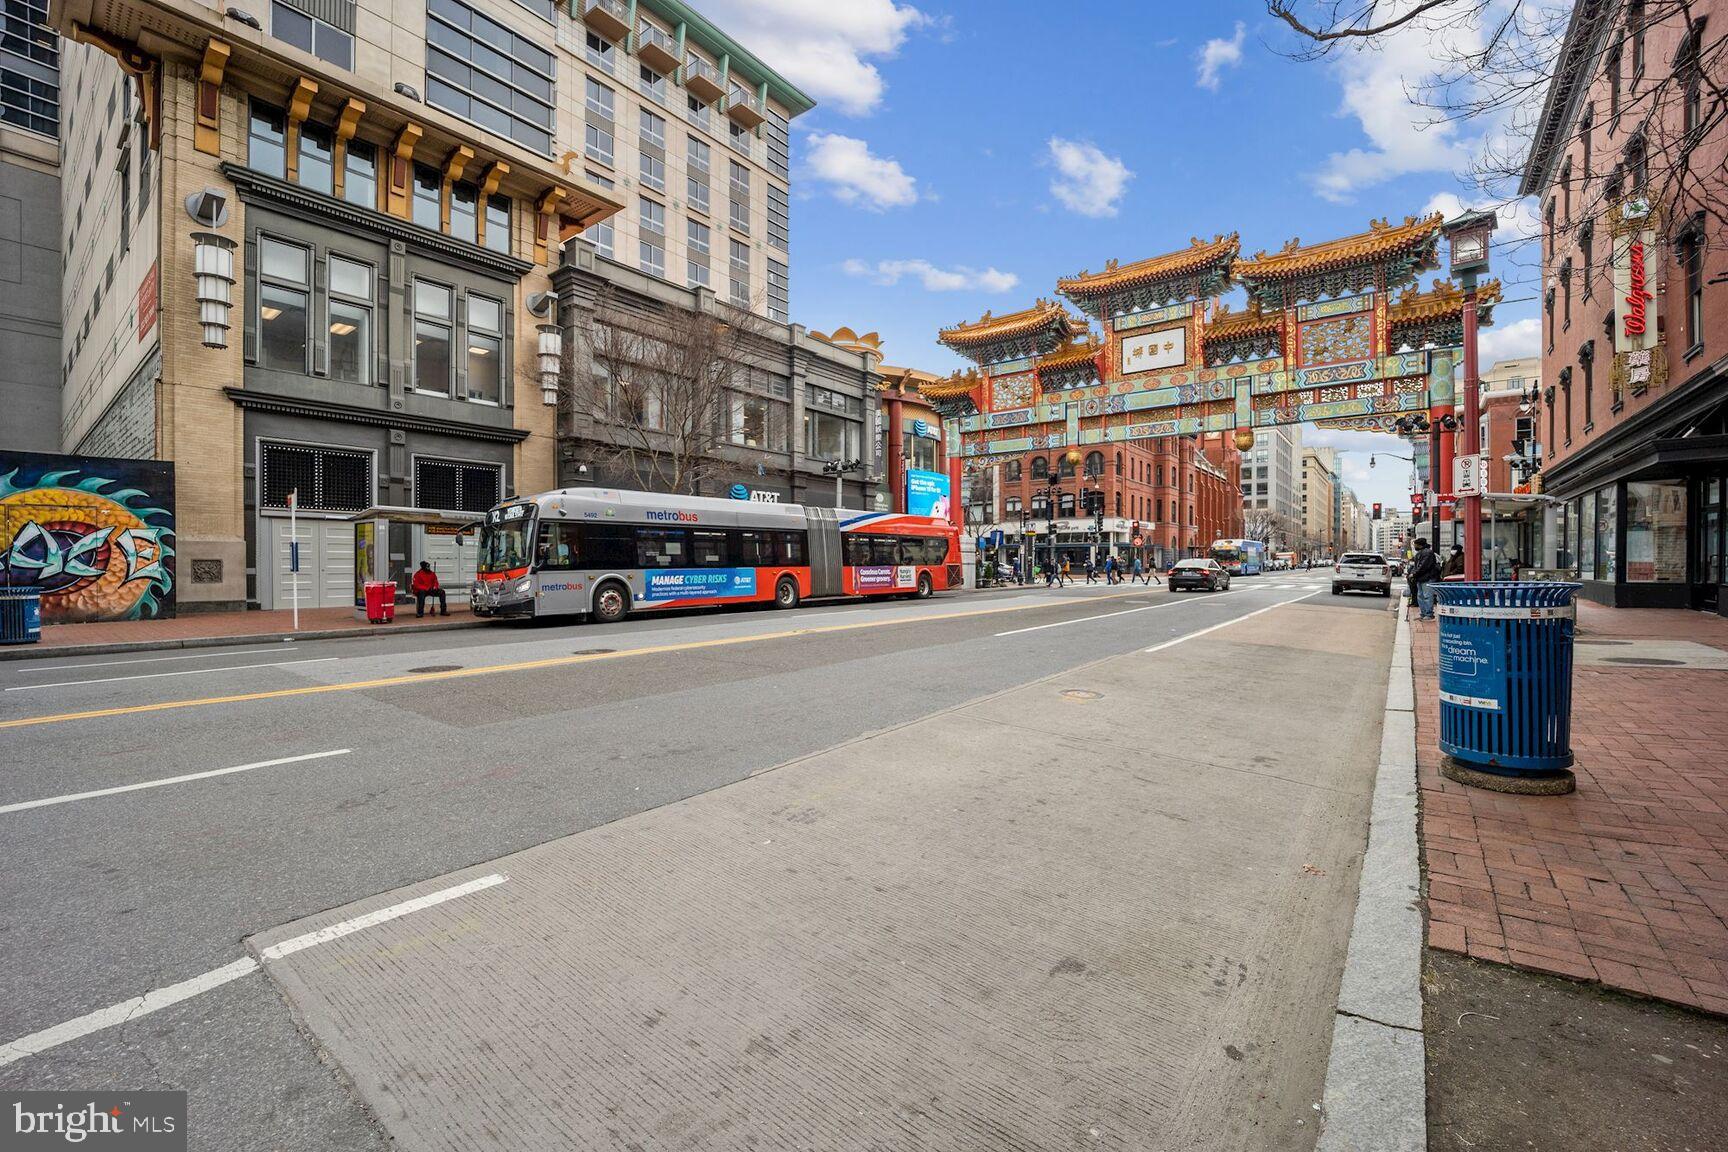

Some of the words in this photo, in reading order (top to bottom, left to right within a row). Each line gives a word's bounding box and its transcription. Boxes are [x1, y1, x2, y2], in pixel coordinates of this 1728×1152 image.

[751, 490, 780, 504] AT&T
[491, 510, 501, 523] X2
[646, 510, 699, 522] metrobus
[651, 575, 684, 585] MANAGE
[684, 575, 707, 584] CYBER
[707, 574, 728, 583] RISKS
[541, 582, 583, 592] metrobus
[1448, 645, 1476, 656] dream
